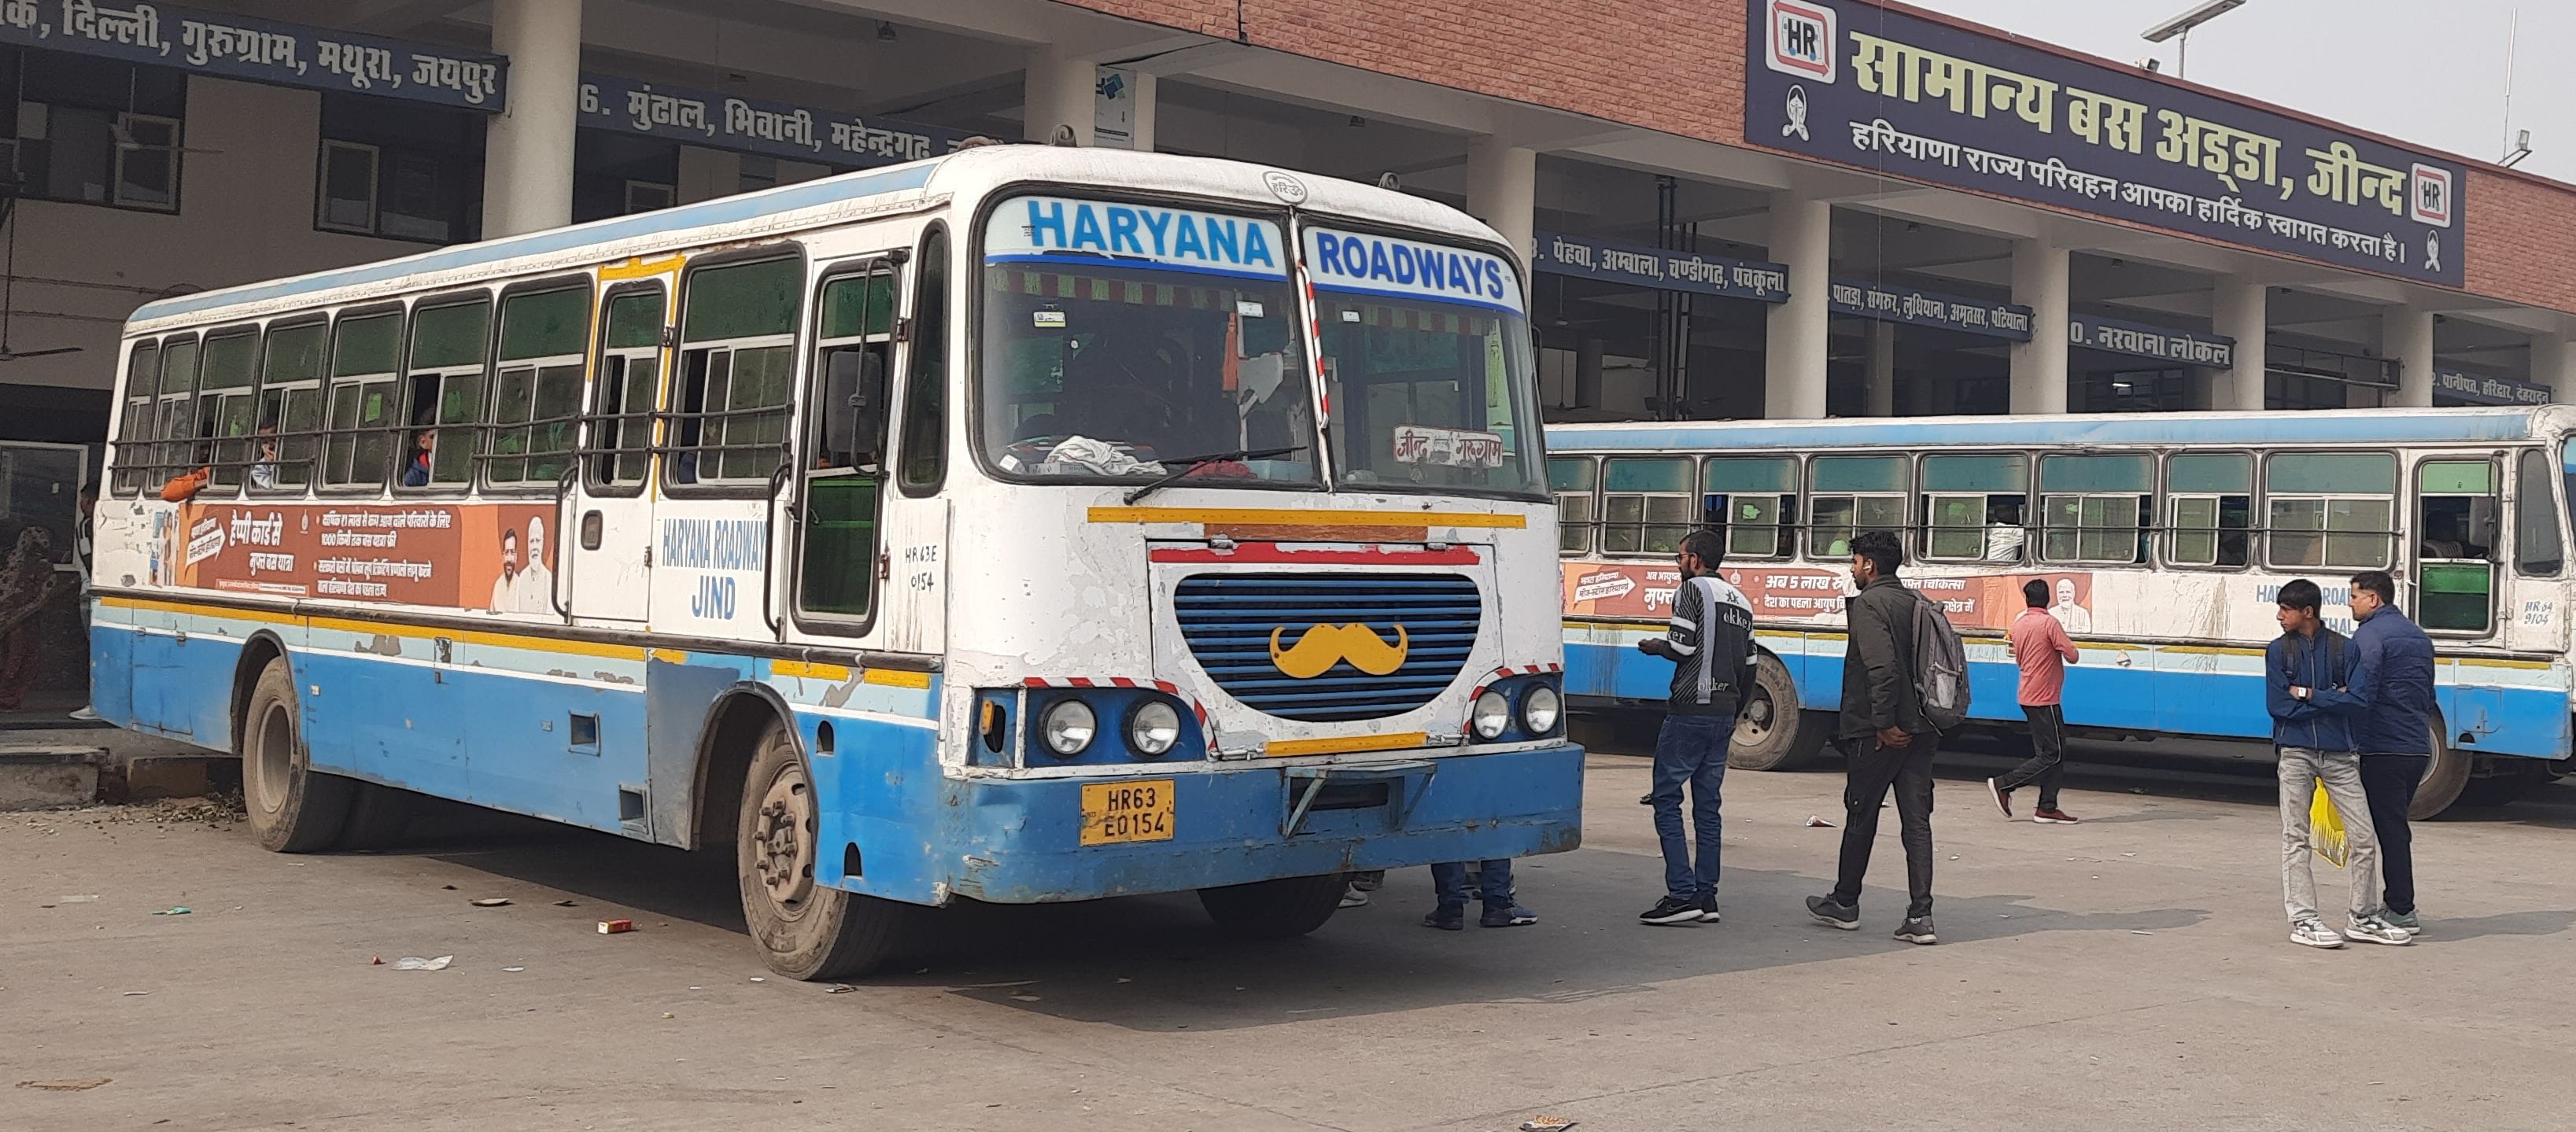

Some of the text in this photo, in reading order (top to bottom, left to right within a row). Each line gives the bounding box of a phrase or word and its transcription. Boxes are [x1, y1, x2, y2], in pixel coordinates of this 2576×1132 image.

[1788, 17, 1817, 61] HR
[411, 53, 498, 104] जयपुर
[579, 83, 611, 116] 6.
[627, 84, 716, 137] मुंढाल,
[725, 98, 822, 153] भिवानी,
[1849, 30, 2059, 134] सामान्य
[2066, 86, 2149, 156] बस
[2305, 141, 2408, 216] जीन्द
[1849, 118, 1960, 168] हरियाणा
[1962, 146, 2025, 182] राज्य
[2028, 157, 2119, 201] परिवहन
[2121, 181, 2194, 216] आपका
[2196, 194, 2264, 230] हार्दिक
[2265, 213, 2328, 245] स्वागत
[2330, 227, 2382, 258] करता
[2423, 180, 2441, 211] HR
[1027, 200, 1504, 300] HARYANA ROADWAYS
[1552, 235, 1597, 273] पेहवा,
[1601, 247, 1665, 282] अम्बाला,
[1668, 256, 1729, 290] चण्डीगढ़,
[1732, 260, 1785, 297] पंचकूला
[1902, 292, 1947, 324] लुधियाना,
[1950, 302, 1989, 329] अमृतसर,
[1991, 305, 2028, 333] पटियाला
[2098, 325, 2166, 357] नरवाना
[2170, 334, 2231, 366] लोकल
[2442, 372, 2480, 396] पानीपत,
[2482, 378, 2514, 402] हरिद्वार,
[2516, 383, 2550, 405] देहरादून
[1397, 429, 1430, 459] जीन्द
[662, 518, 767, 572] HARYANA ROADWAY
[692, 575, 736, 620] JIND
[910, 570, 934, 594] 0154
[1764, 592, 1777, 608] देश
[1778, 597, 1789, 608] का
[1791, 598, 1811, 608] पहला
[1813, 598, 1835, 612] आयुष
[1765, 575, 1788, 588] अब
[1789, 576, 1799, 588] 5
[1800, 576, 1830, 589] लाख
[1965, 598, 1975, 613] में
[1698, 677, 1731, 692] okker
[1108, 787, 1156, 812] HR63
[1104, 812, 1164, 837] E0154
